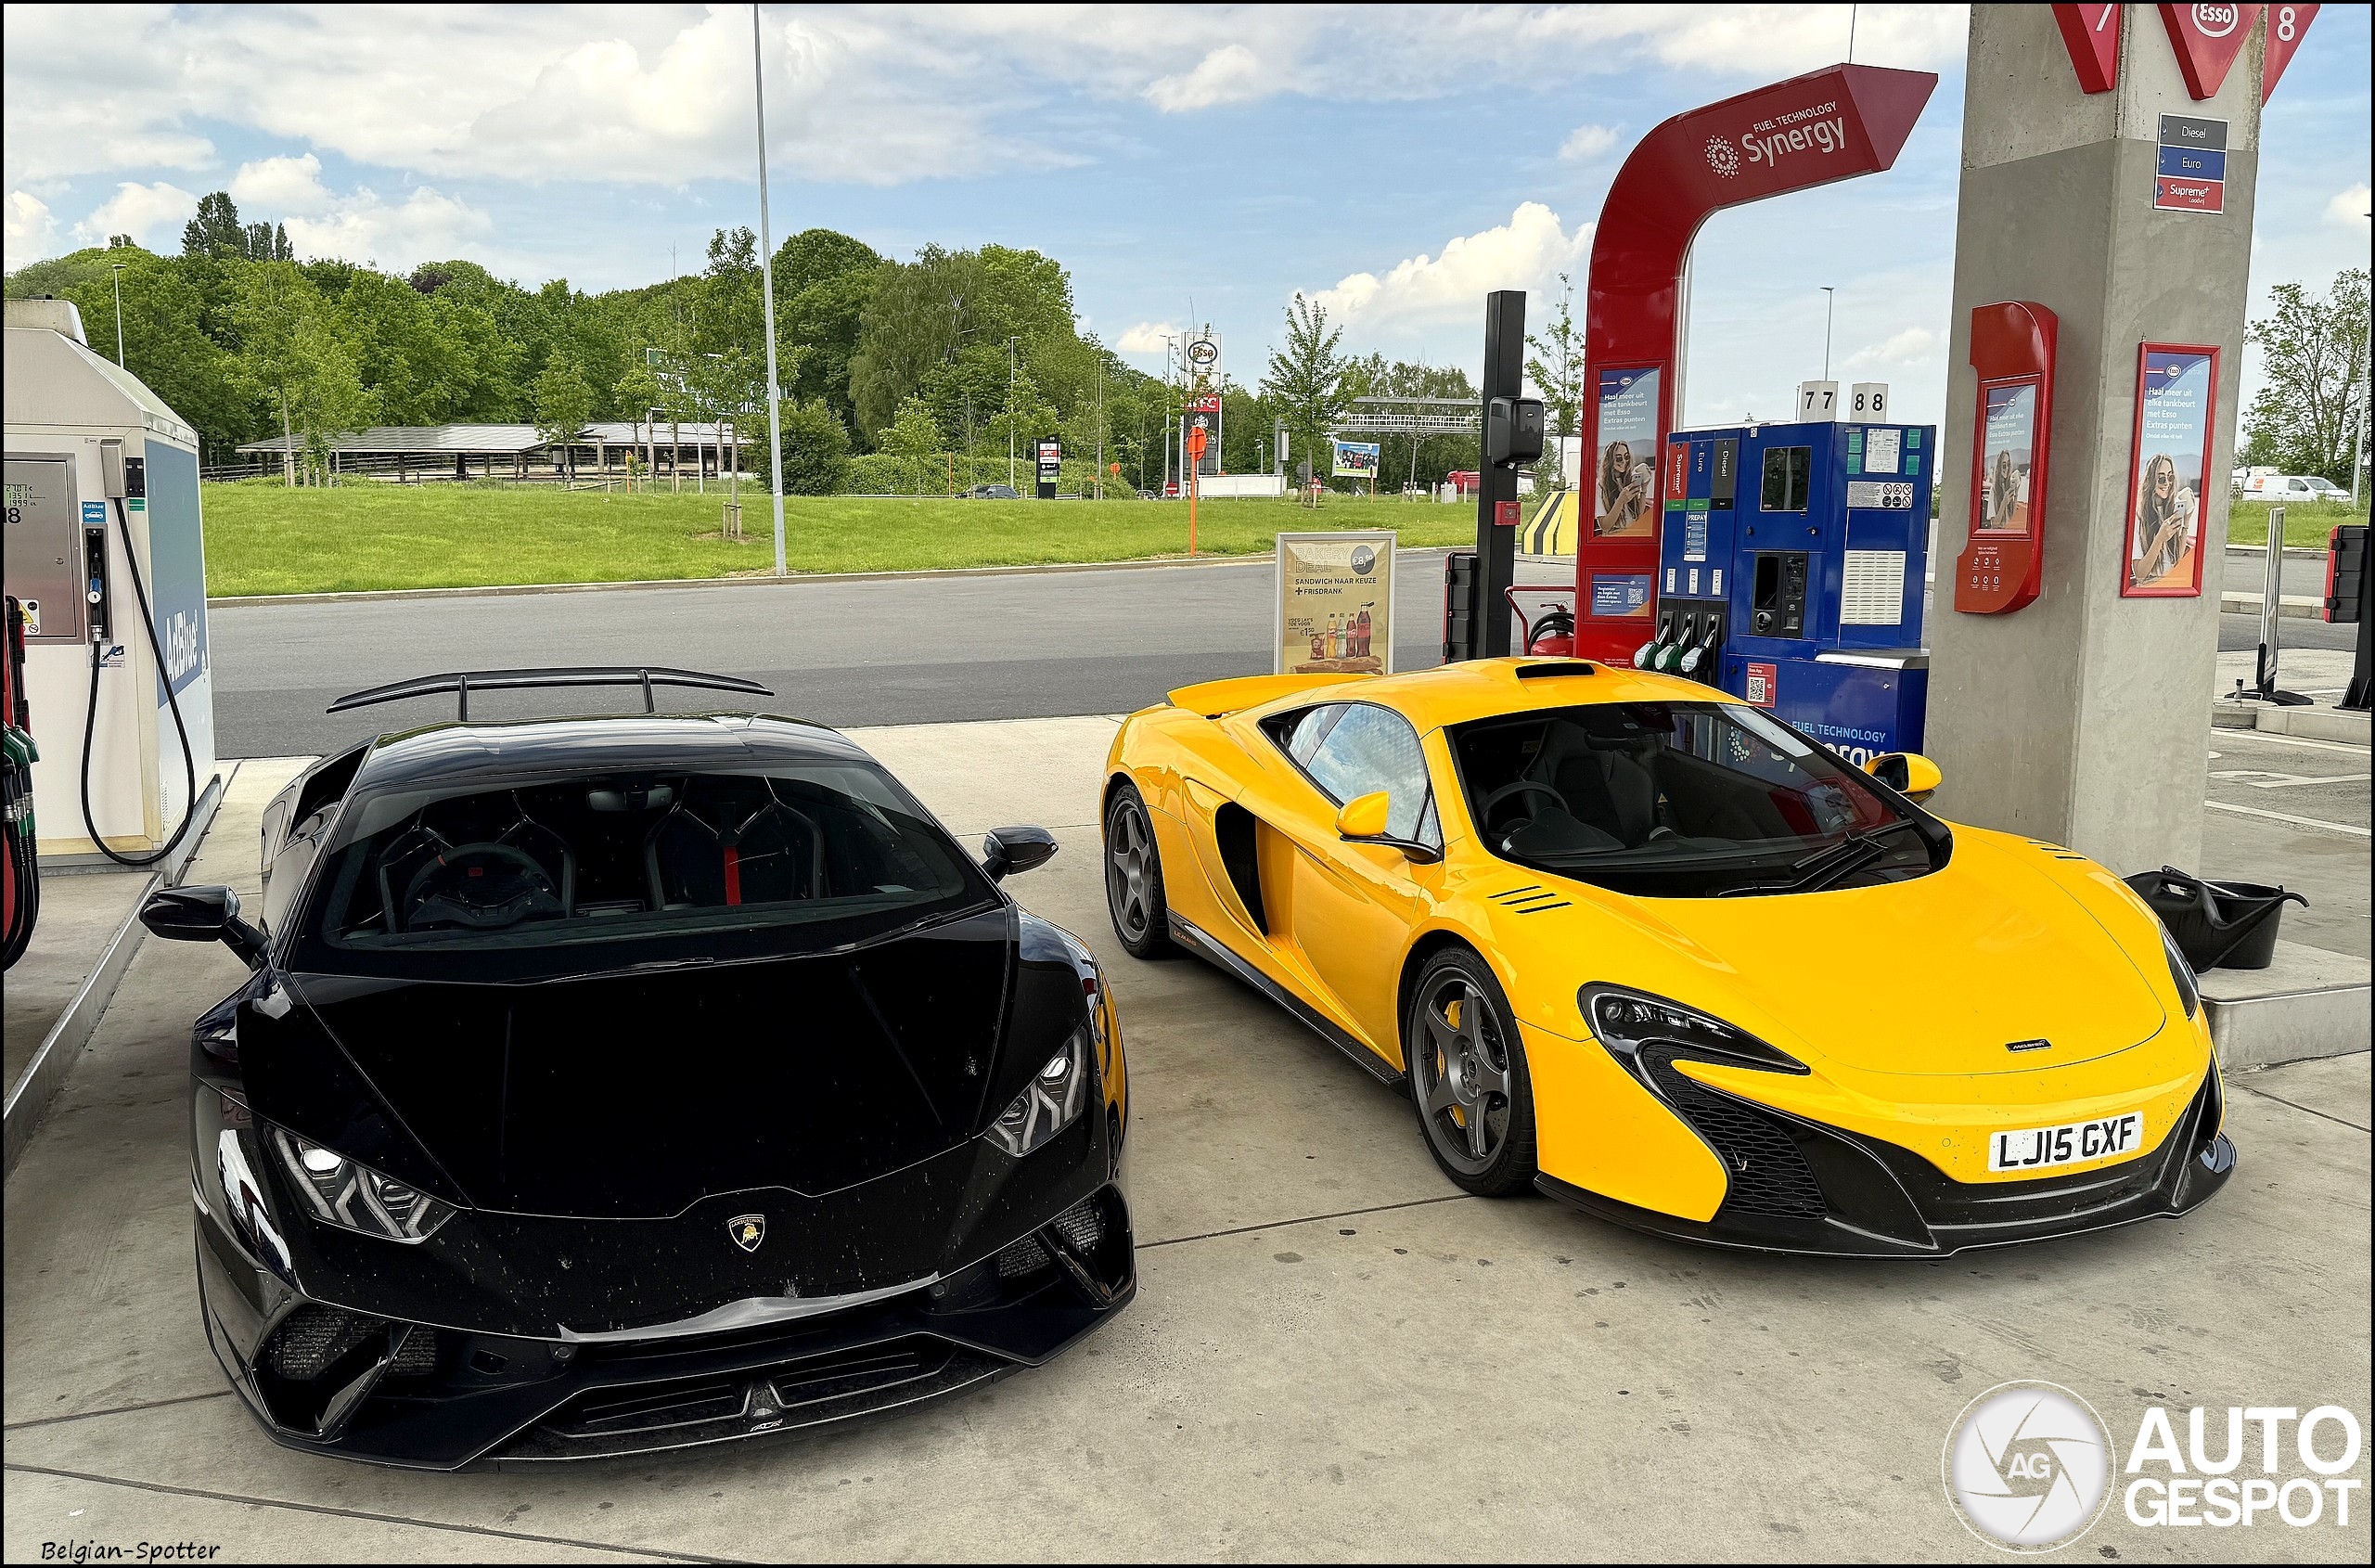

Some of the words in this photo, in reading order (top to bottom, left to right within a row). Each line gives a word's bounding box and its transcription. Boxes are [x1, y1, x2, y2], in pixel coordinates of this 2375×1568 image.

[2278, 6, 2296, 42] 8
[1752, 119, 1777, 134] FUEL
[1778, 100, 1837, 126] TECHNOLOGY
[2181, 125, 2206, 138] Diesel
[1741, 117, 1846, 167] Synergy
[2182, 157, 2202, 169] Euro
[1805, 391, 1815, 410] 7
[1823, 391, 1833, 410] 7
[2149, 386, 2164, 396] Haal
[2164, 389, 2182, 397] meer
[2183, 388, 2192, 397] uit
[1617, 400, 1648, 408] tankbeurt
[1855, 392, 1865, 412] 8
[1872, 392, 1883, 412] 8
[2148, 399, 2162, 407] elke
[2163, 399, 2196, 408] tankbeurt
[2162, 410, 2177, 418] Esso
[2146, 420, 2168, 429] Extras
[2168, 422, 2192, 431] punten
[1697, 452, 1705, 472] Euro
[1721, 450, 1729, 477] Diesel
[1295, 547, 1351, 559] BAKERY
[1295, 561, 1332, 573] DEAL
[1303, 587, 1343, 596] FRISDRANK
[1791, 720, 1816, 734] FUEL
[1817, 724, 1886, 743] TECHNOLOGY
[1999, 1127, 2073, 1167] LJ15
[2082, 1115, 2136, 1158] GXF
